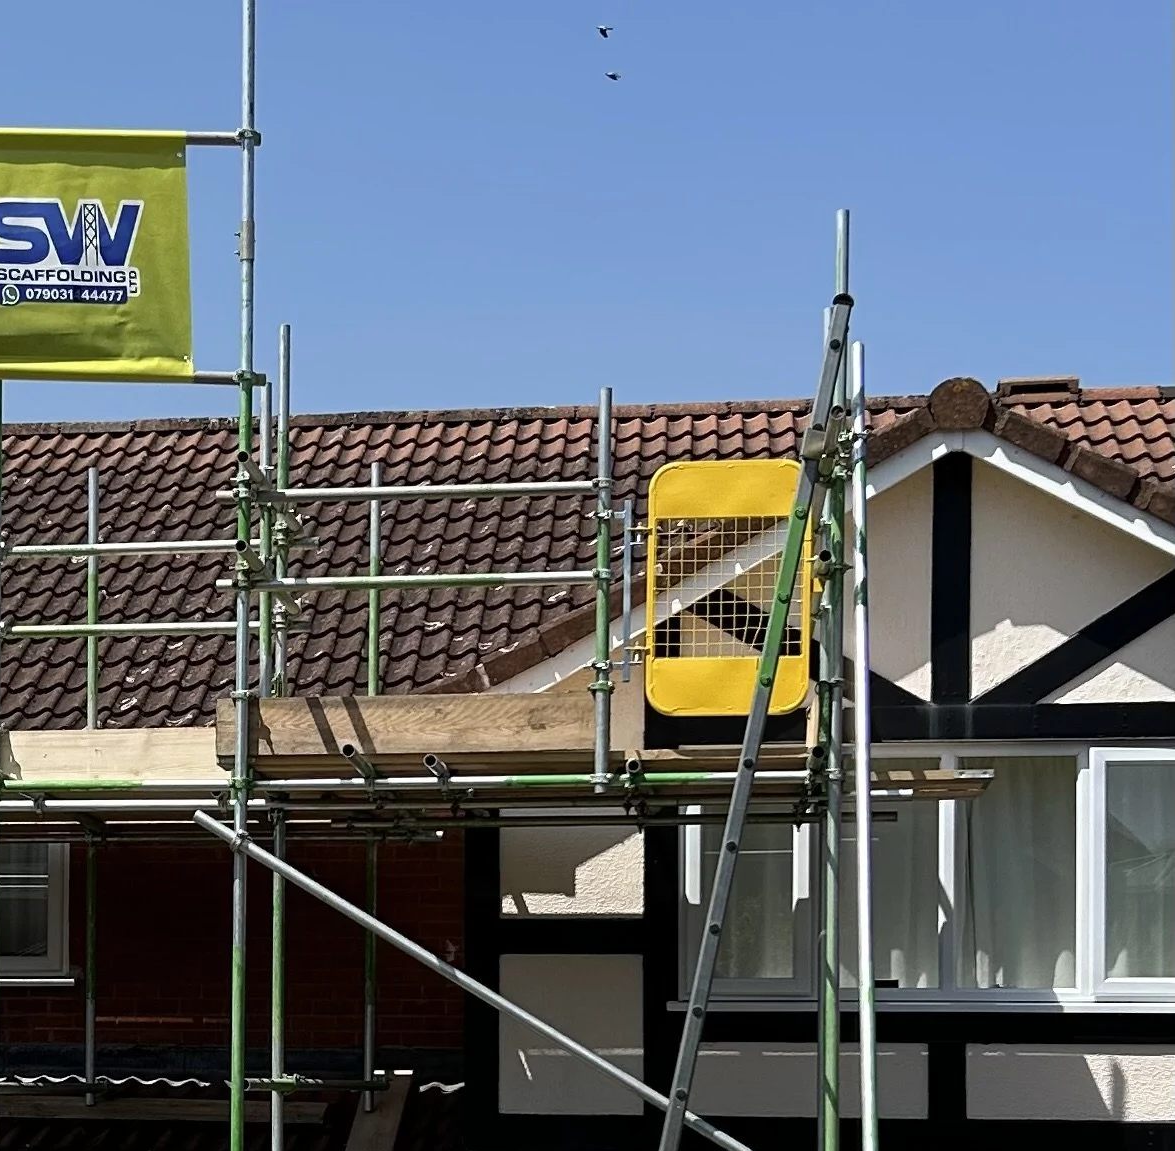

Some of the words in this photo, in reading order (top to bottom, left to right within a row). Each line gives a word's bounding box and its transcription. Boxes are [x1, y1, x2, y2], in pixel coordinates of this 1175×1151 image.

[128, 270, 138, 294] LTD
[25, 288, 74, 300] 079031
[81, 290, 124, 302] 44477
